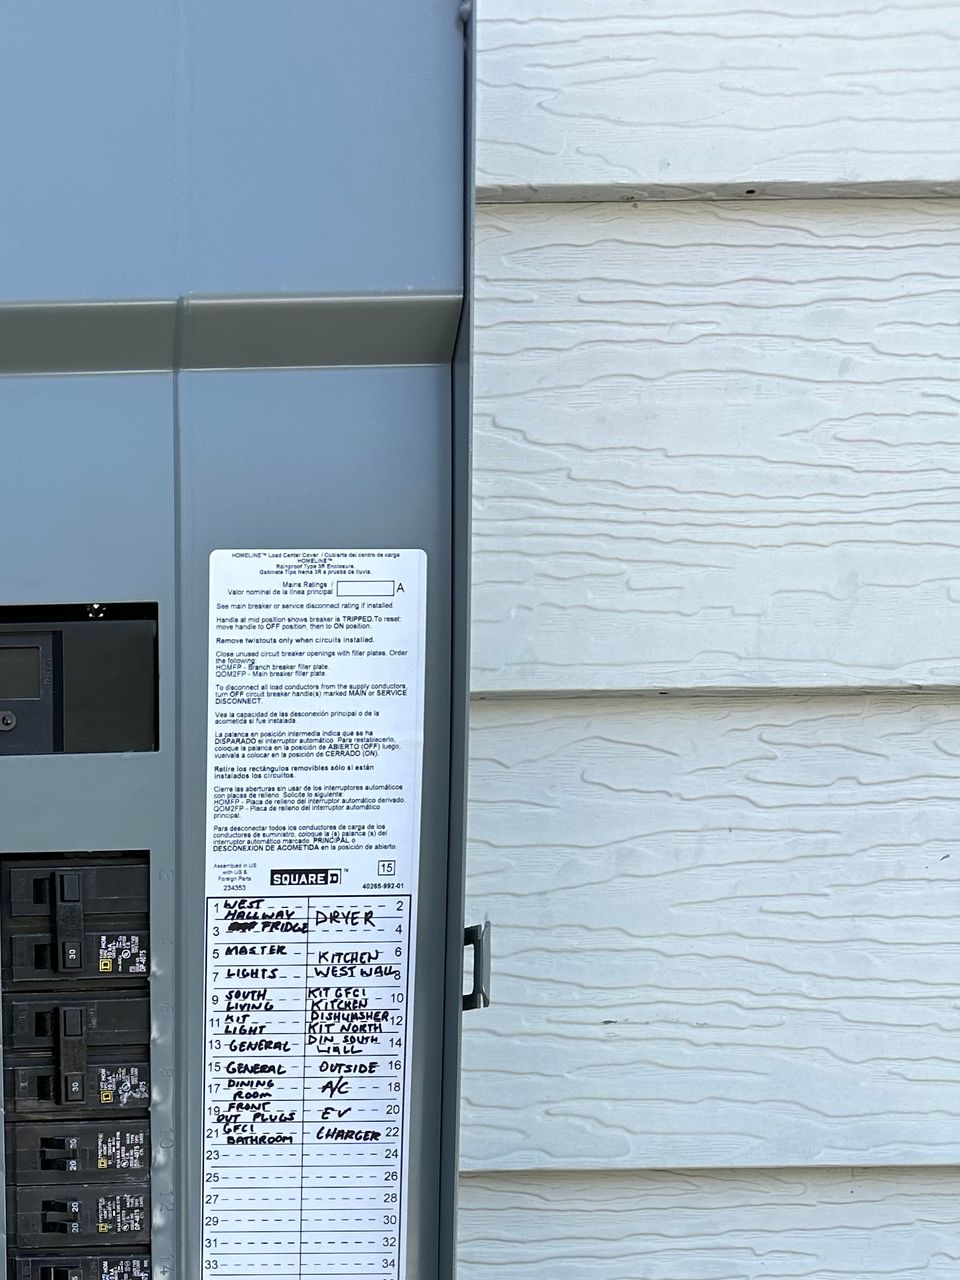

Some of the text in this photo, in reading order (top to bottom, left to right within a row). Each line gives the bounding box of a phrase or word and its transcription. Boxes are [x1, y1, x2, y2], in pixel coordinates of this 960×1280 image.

[304, 581, 327, 589] Ratings
[396, 583, 405, 592] A
[381, 863, 393, 872] 15
[273, 874, 325, 884] SQUARE
[214, 903, 218, 913] 1
[224, 900, 264, 909] WEST
[397, 901, 403, 911] 2
[224, 910, 295, 920] HALLWAY
[316, 911, 375, 927] DRYER
[213, 927, 219, 936] 3
[261, 921, 308, 934] FRIDGE
[395, 924, 402, 934] 4
[69, 949, 76, 959] 30
[213, 949, 219, 959] 5
[225, 946, 288, 955] MASTER
[395, 947, 402, 957] 6
[319, 950, 379, 964] KITCHEN
[226, 968, 278, 979] LIGHTS
[314, 966, 396, 977] WEST WALL
[394, 971, 401, 980] 8
[212, 972, 219, 982] 7
[226, 988, 267, 1001] SOUTH
[308, 987, 366, 998] KIT GFCI
[212, 995, 218, 1005] 9
[391, 993, 404, 1003] 10
[226, 1002, 274, 1011] LIVING
[311, 999, 367, 1010] KITCHEN
[209, 1018, 219, 1027] 11
[225, 1014, 250, 1023] KIT
[390, 1016, 403, 1025] 12
[224, 1025, 266, 1035] LIGHT
[308, 1022, 382, 1033] KIT NORTH
[209, 1040, 221, 1049] 13
[307, 1035, 334, 1045] DIN
[389, 1038, 402, 1047] 14
[229, 1039, 291, 1052] GENERAL
[317, 1046, 362, 1054] WALL
[208, 1062, 221, 1072] 15
[226, 1061, 286, 1074] GENERAL
[319, 1061, 378, 1073] OUTSIDE
[388, 1060, 401, 1070] 16
[72, 1082, 79, 1092] 30
[208, 1084, 220, 1093] 17
[228, 1080, 274, 1088] DINING
[321, 1076, 349, 1098] A/C
[388, 1082, 400, 1092] 18
[233, 1092, 272, 1100] ROOM
[208, 1107, 220, 1116] 19
[228, 1102, 271, 1111] FRONT
[386, 1104, 400, 1114] 20
[216, 1112, 295, 1123] OUT PLUGS
[321, 1107, 351, 1120] EV
[206, 1129, 218, 1138] 21
[223, 1124, 254, 1134] GFCI
[316, 1126, 381, 1141] CHARGER
[385, 1127, 399, 1137] 22
[70, 1138, 77, 1149] 20
[227, 1135, 293, 1144] BATHROOM
[206, 1150, 219, 1160] 23
[385, 1149, 398, 1158] 24
[69, 1160, 77, 1171] 20
[206, 1173, 219, 1182] 25
[384, 1171, 398, 1181] 26
[206, 1195, 219, 1204] 27
[384, 1193, 397, 1203] 28
[71, 1202, 79, 1212] 20
[205, 1217, 218, 1226] 29
[384, 1215, 397, 1224] 30
[72, 1223, 79, 1233] 20
[205, 1238, 217, 1248] 31
[383, 1237, 396, 1247] 32
[205, 1260, 218, 1269] 33
[382, 1259, 395, 1268] 34
